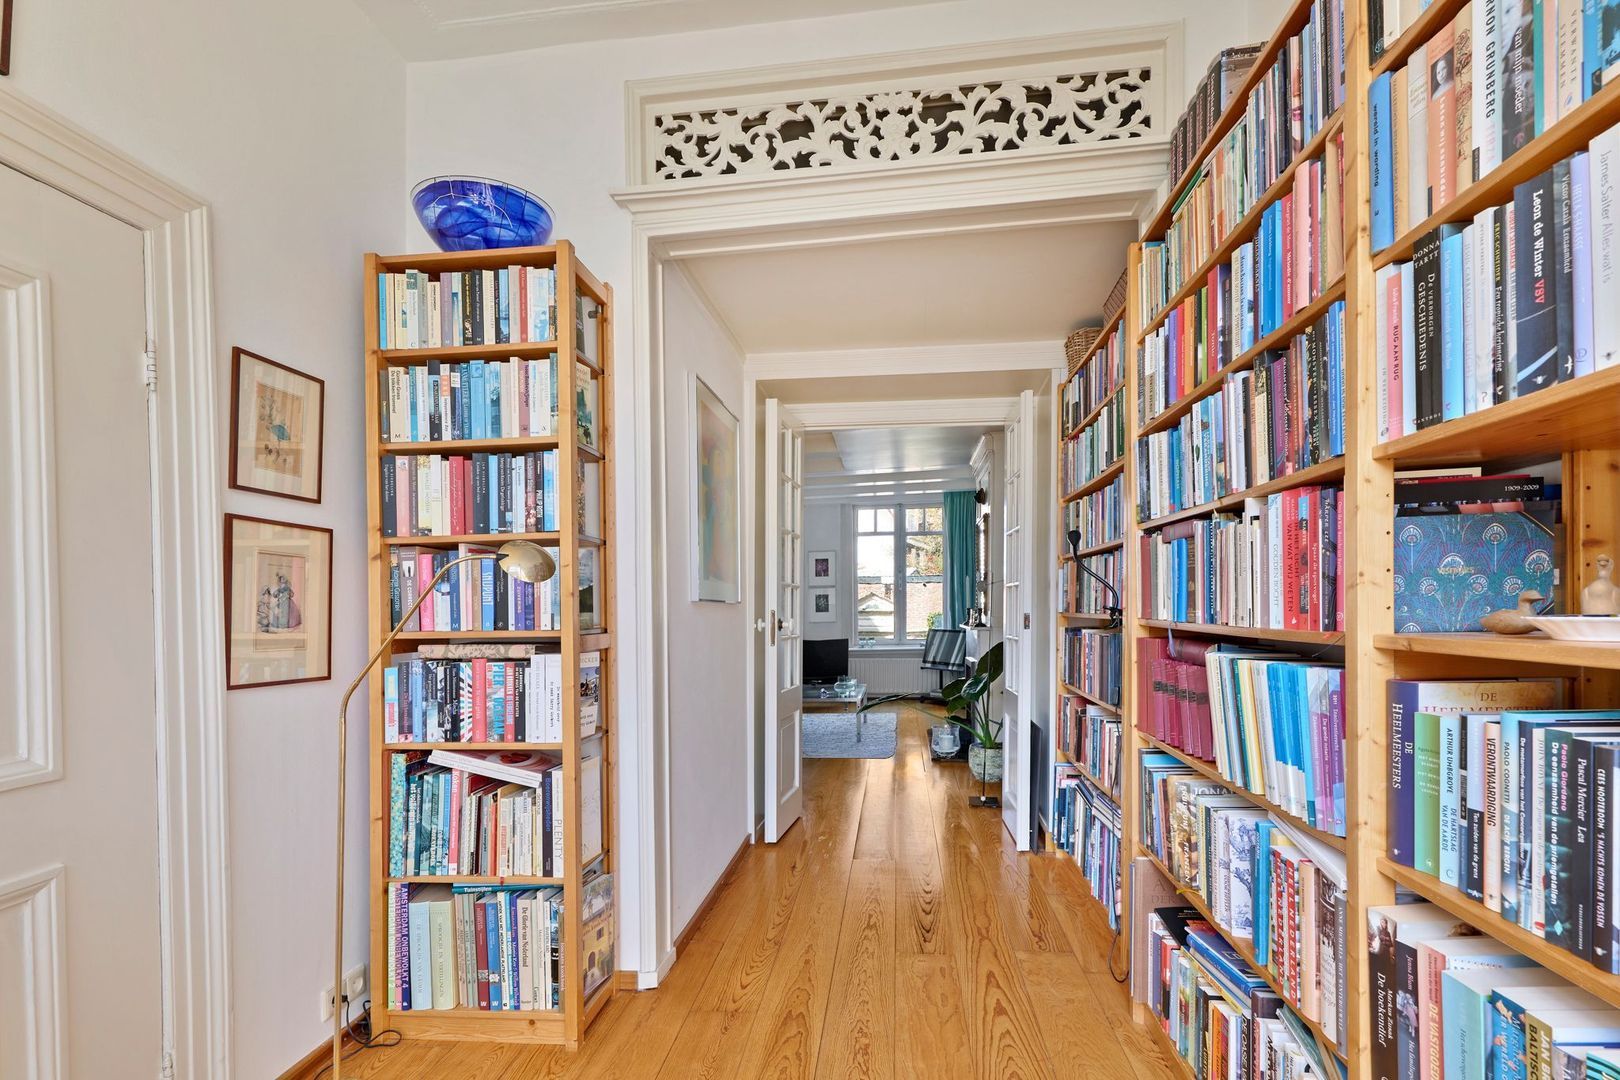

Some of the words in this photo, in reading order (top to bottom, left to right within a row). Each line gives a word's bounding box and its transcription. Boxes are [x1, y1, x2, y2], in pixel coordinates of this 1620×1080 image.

[1514, 29, 1524, 49] van
[1486, 43, 1496, 118] GRUNBERG
[1514, 76, 1525, 114] moeder
[1374, 137, 1380, 147] in
[1562, 174, 1570, 199] Victor
[1532, 189, 1544, 220] Leon
[1600, 185, 1612, 220] Salter
[1533, 222, 1544, 236] de
[1601, 222, 1613, 252] Alles
[1412, 240, 1440, 260] DONNA
[1414, 250, 1438, 268] TARTT
[1533, 237, 1545, 278] Winter
[1602, 254, 1612, 272] wat
[1427, 273, 1435, 286] De
[1603, 274, 1613, 284] is
[1535, 279, 1545, 304] VSV
[1418, 282, 1427, 371] GESCHIEDENIS
[1504, 484, 1540, 492] 1909-2009
[493, 664, 505, 686] PIER
[1480, 692, 1497, 702] DE
[1392, 703, 1403, 789] HEELMEESTERS
[1404, 742, 1413, 754] DE
[1520, 737, 1526, 747] De
[1551, 742, 1559, 753] De
[451, 770, 459, 793] Koken
[1446, 757, 1454, 793] UMBGROVE
[1577, 758, 1587, 785] Pascal
[1597, 768, 1605, 785] CEES
[1487, 738, 1496, 827] VERONTWAARDIGING
[1551, 756, 1559, 814] eenzaamheid
[1450, 808, 1457, 816] DE
[1577, 786, 1587, 821] Mercier
[1597, 786, 1605, 829] NOOTEBOOM
[1441, 819, 1448, 827] DE
[1504, 814, 1511, 823] DE
[554, 819, 563, 860] PLENTY
[1551, 833, 1559, 844] de
[1577, 825, 1587, 843] Lea
[1471, 862, 1479, 879] grens
[1549, 846, 1559, 904] priemgetallen
[1596, 865, 1605, 890] KOMEN
[1597, 891, 1605, 901] DE
[1596, 902, 1605, 928] VOSSEN
[1406, 955, 1414, 973] Jenna
[1377, 972, 1386, 988] De
[1377, 989, 1387, 1048] boekendief
[1429, 1003, 1438, 1020] DE
[1540, 1031, 1550, 1062] JAN
[1541, 1063, 1551, 1080] BR
